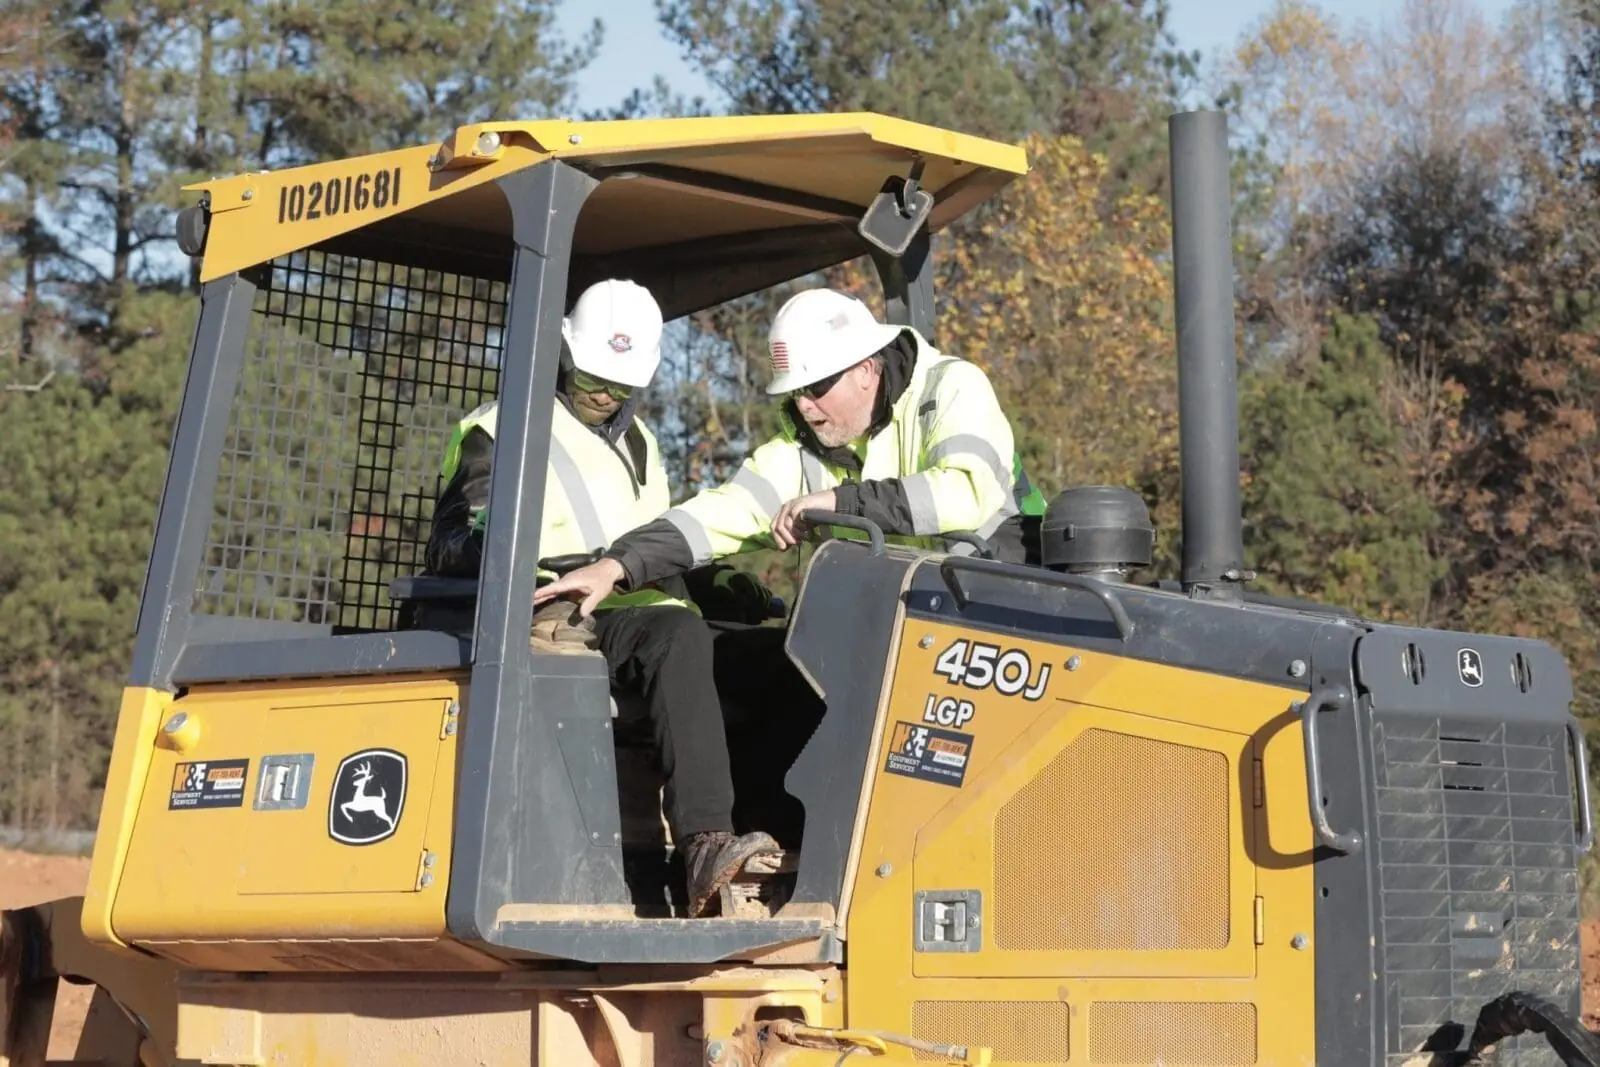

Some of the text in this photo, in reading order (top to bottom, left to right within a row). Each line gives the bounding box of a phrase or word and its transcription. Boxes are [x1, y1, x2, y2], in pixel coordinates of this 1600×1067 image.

[278, 167, 401, 224] 10201681
[933, 638, 1052, 701] 450J
[923, 693, 975, 728] LGP
[890, 723, 929, 758] H&E
[173, 763, 207, 791] H&E
